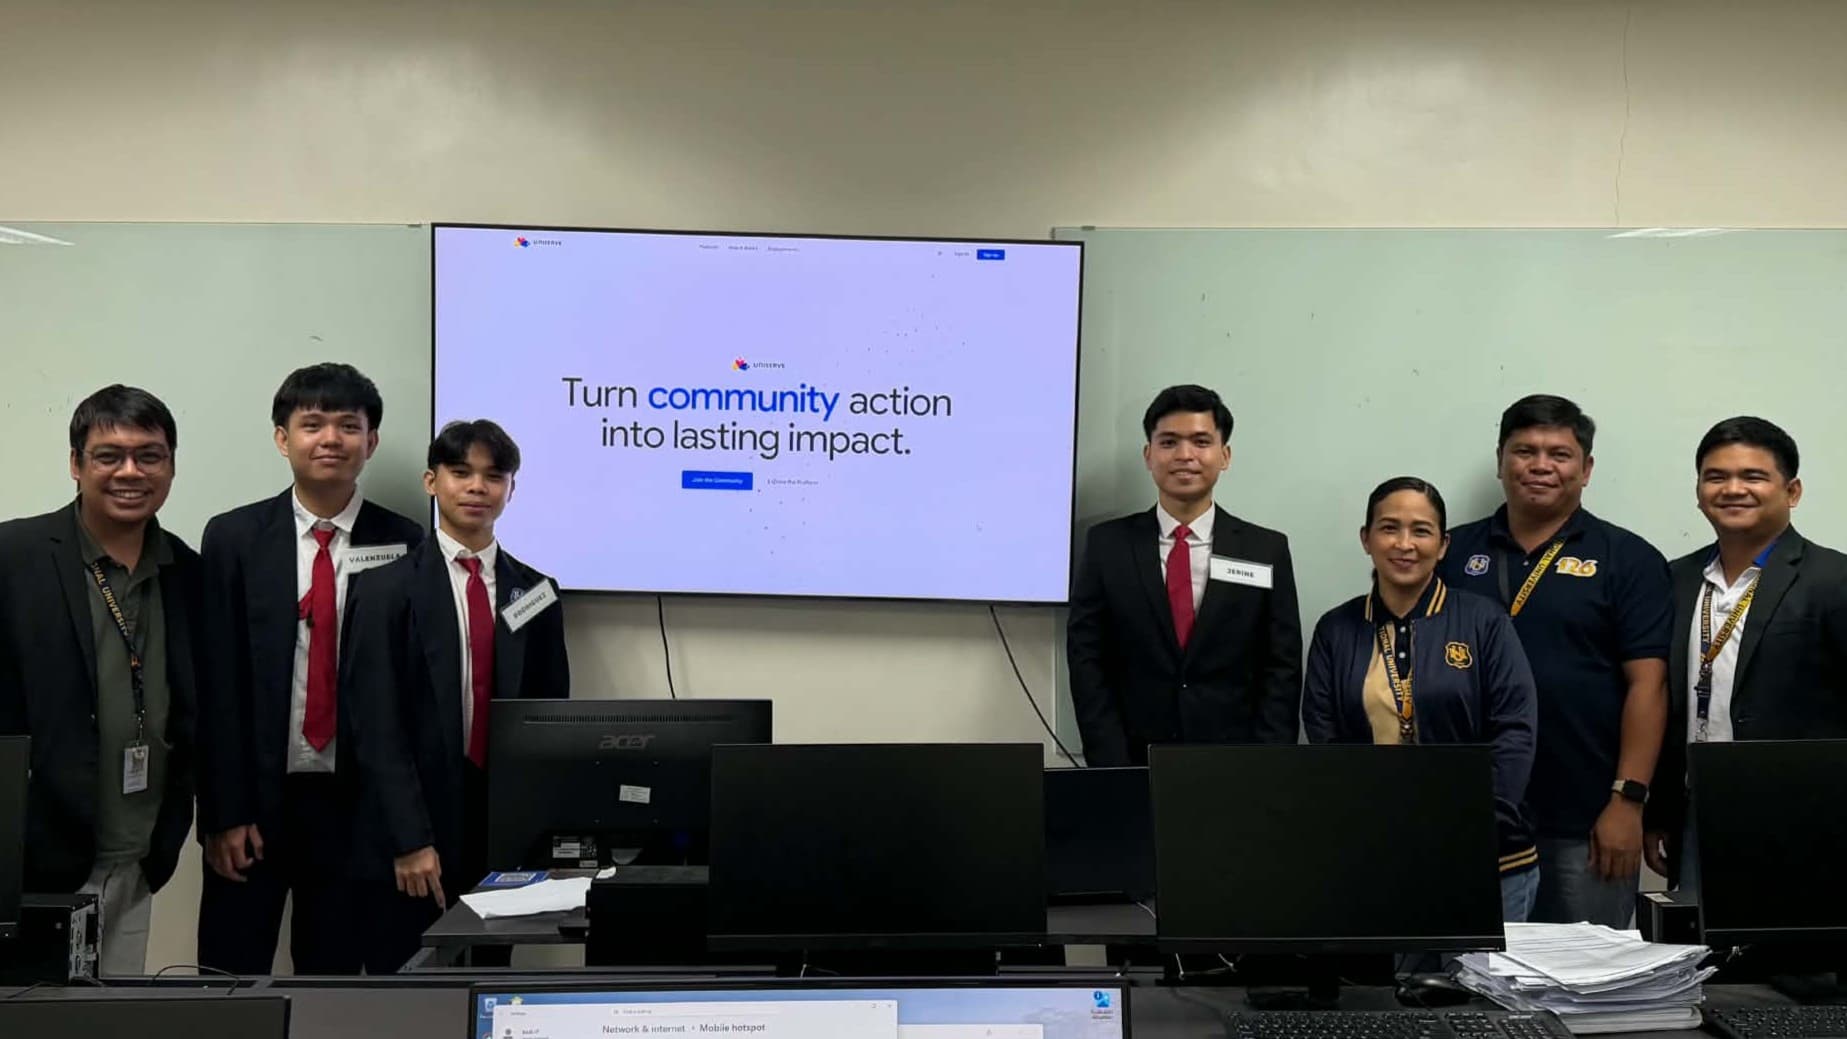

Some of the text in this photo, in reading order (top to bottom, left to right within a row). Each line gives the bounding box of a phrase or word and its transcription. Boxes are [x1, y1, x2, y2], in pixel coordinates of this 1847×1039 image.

[562, 377, 952, 421] Turn community action
[601, 418, 911, 461] into lasting impact.
[1227, 568, 1255, 578] JERINE
[1517, 560, 1549, 604] UNIVERSITY
[1555, 556, 1598, 577] 126
[102, 586, 129, 637] UNIVERSITY
[1713, 601, 1745, 651] UNIVERSITY
[1384, 650, 1403, 701] UNIVERSITY
[600, 735, 656, 749] acer
[602, 1024, 639, 1034] Network
[700, 1023, 729, 1033] Mobile
[731, 1023, 765, 1034] hotspot
